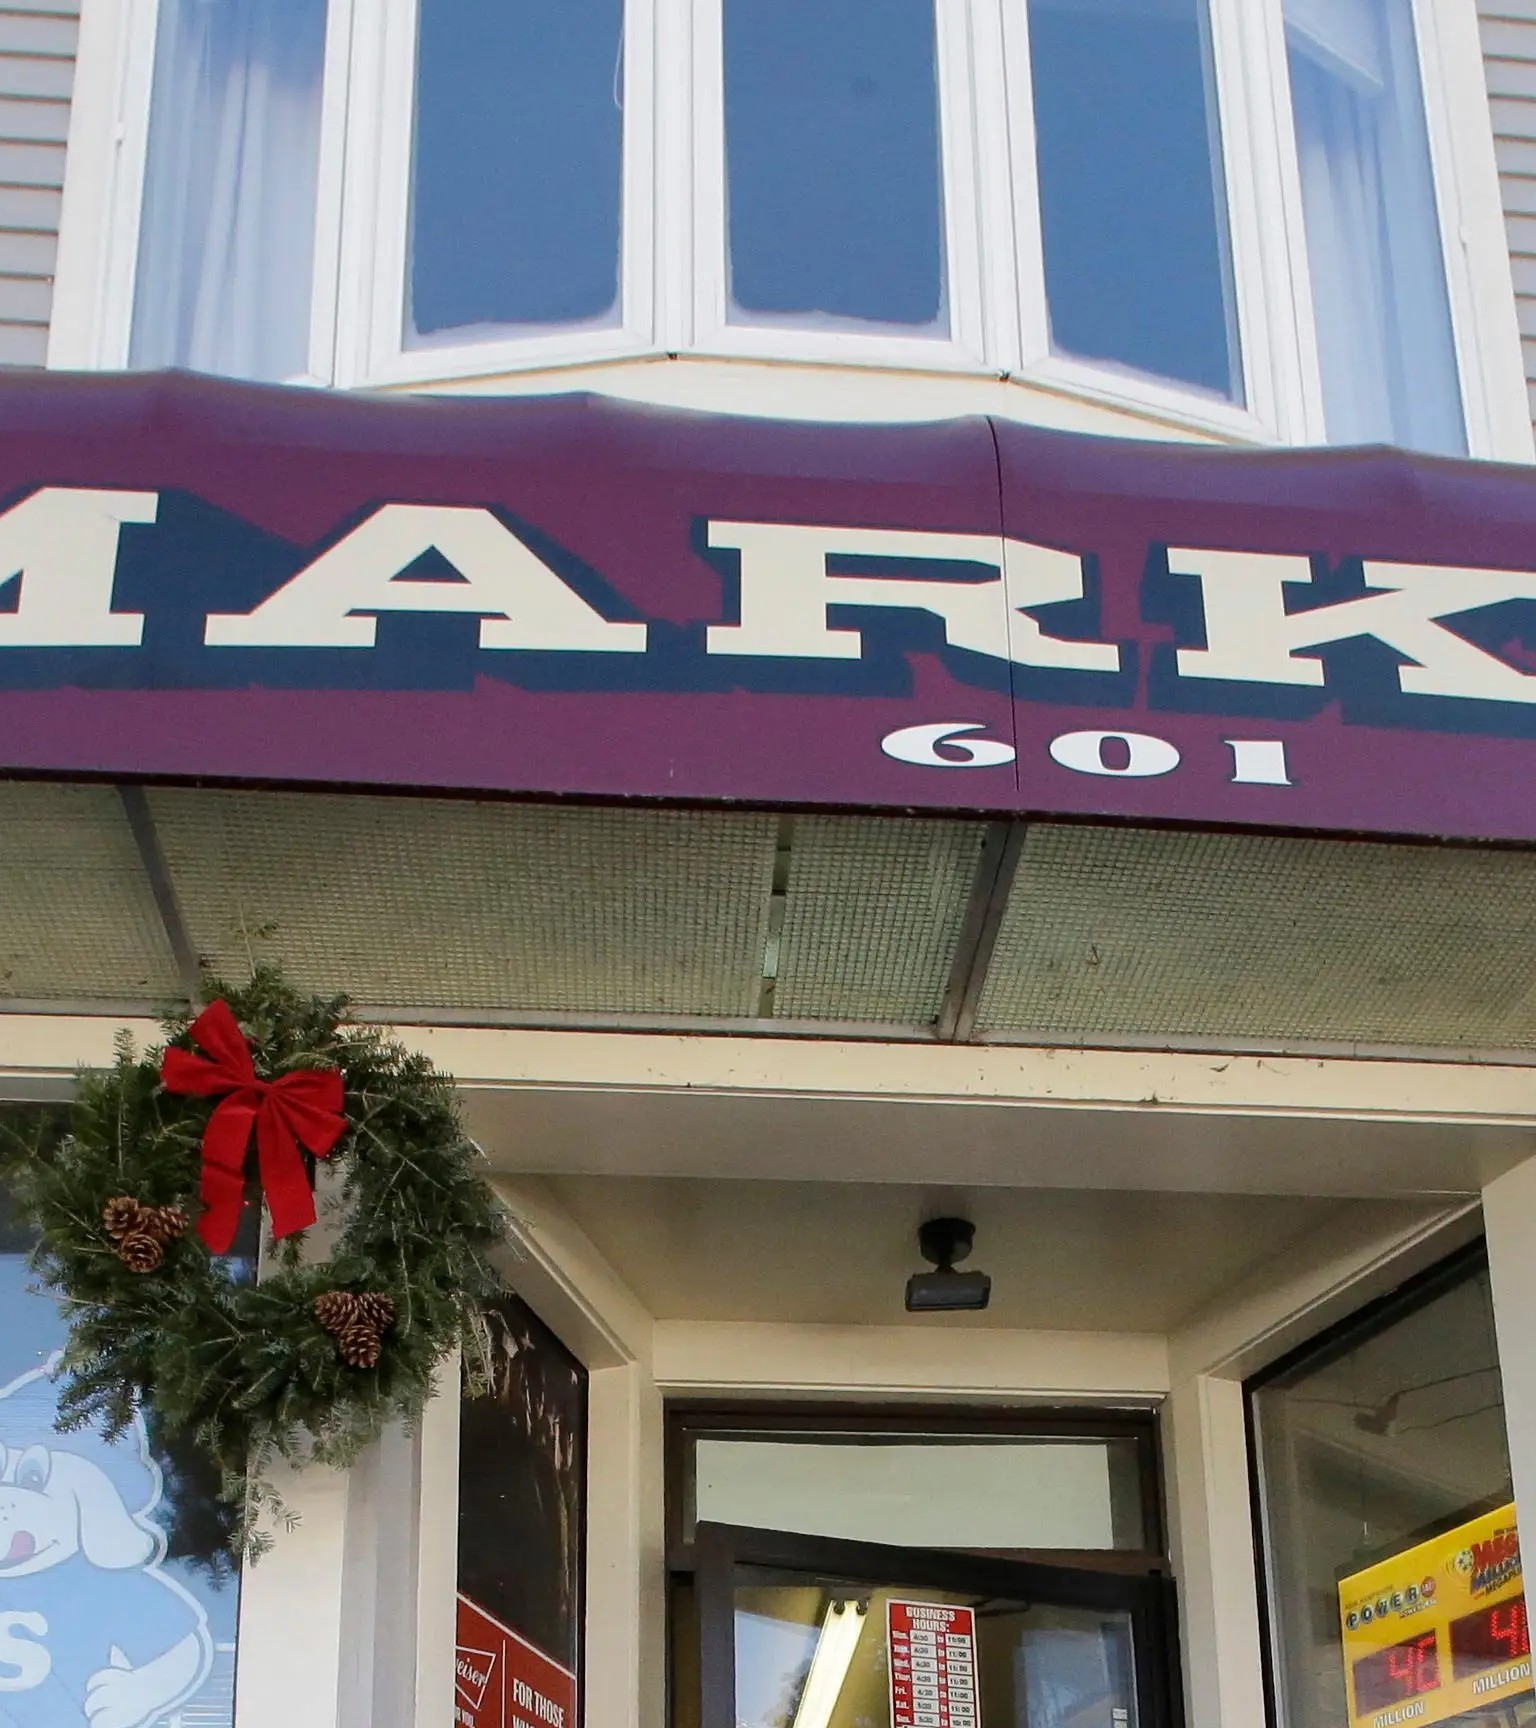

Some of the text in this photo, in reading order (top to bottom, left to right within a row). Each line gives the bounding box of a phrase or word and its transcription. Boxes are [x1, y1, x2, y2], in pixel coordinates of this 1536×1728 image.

[880, 721, 1293, 788] 601
[905, 1606, 956, 1622] BUSINESS
[1346, 1584, 1420, 1631] POWER
[912, 1618, 950, 1633] HOURS:
[513, 1676, 533, 1712] FOR
[894, 1685, 907, 1695] Fri.
[1472, 1662, 1531, 1695] MILLION
